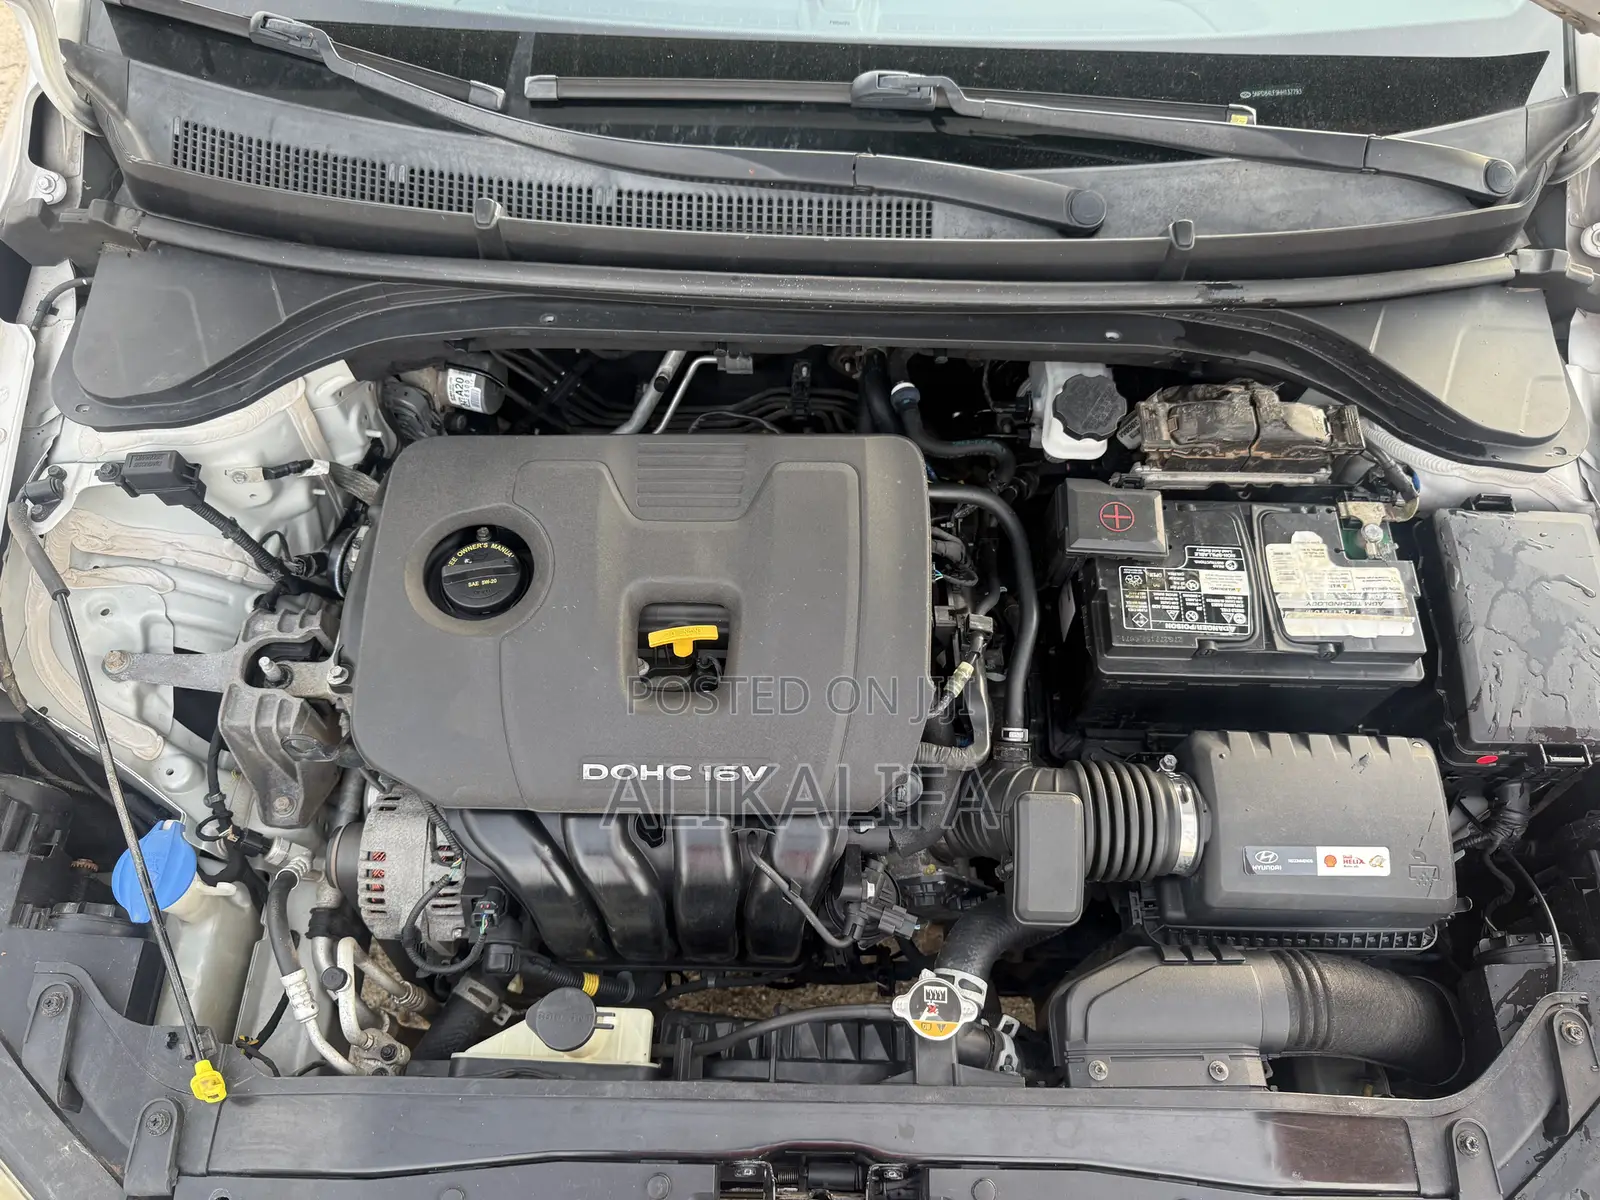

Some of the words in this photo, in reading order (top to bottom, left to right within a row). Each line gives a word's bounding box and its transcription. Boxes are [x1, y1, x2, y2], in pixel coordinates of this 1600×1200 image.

[458, 542, 489, 557] OWNER'S
[491, 542, 514, 559] MANUA
[581, 763, 692, 781] DOHC
[703, 764, 769, 782] 16V
